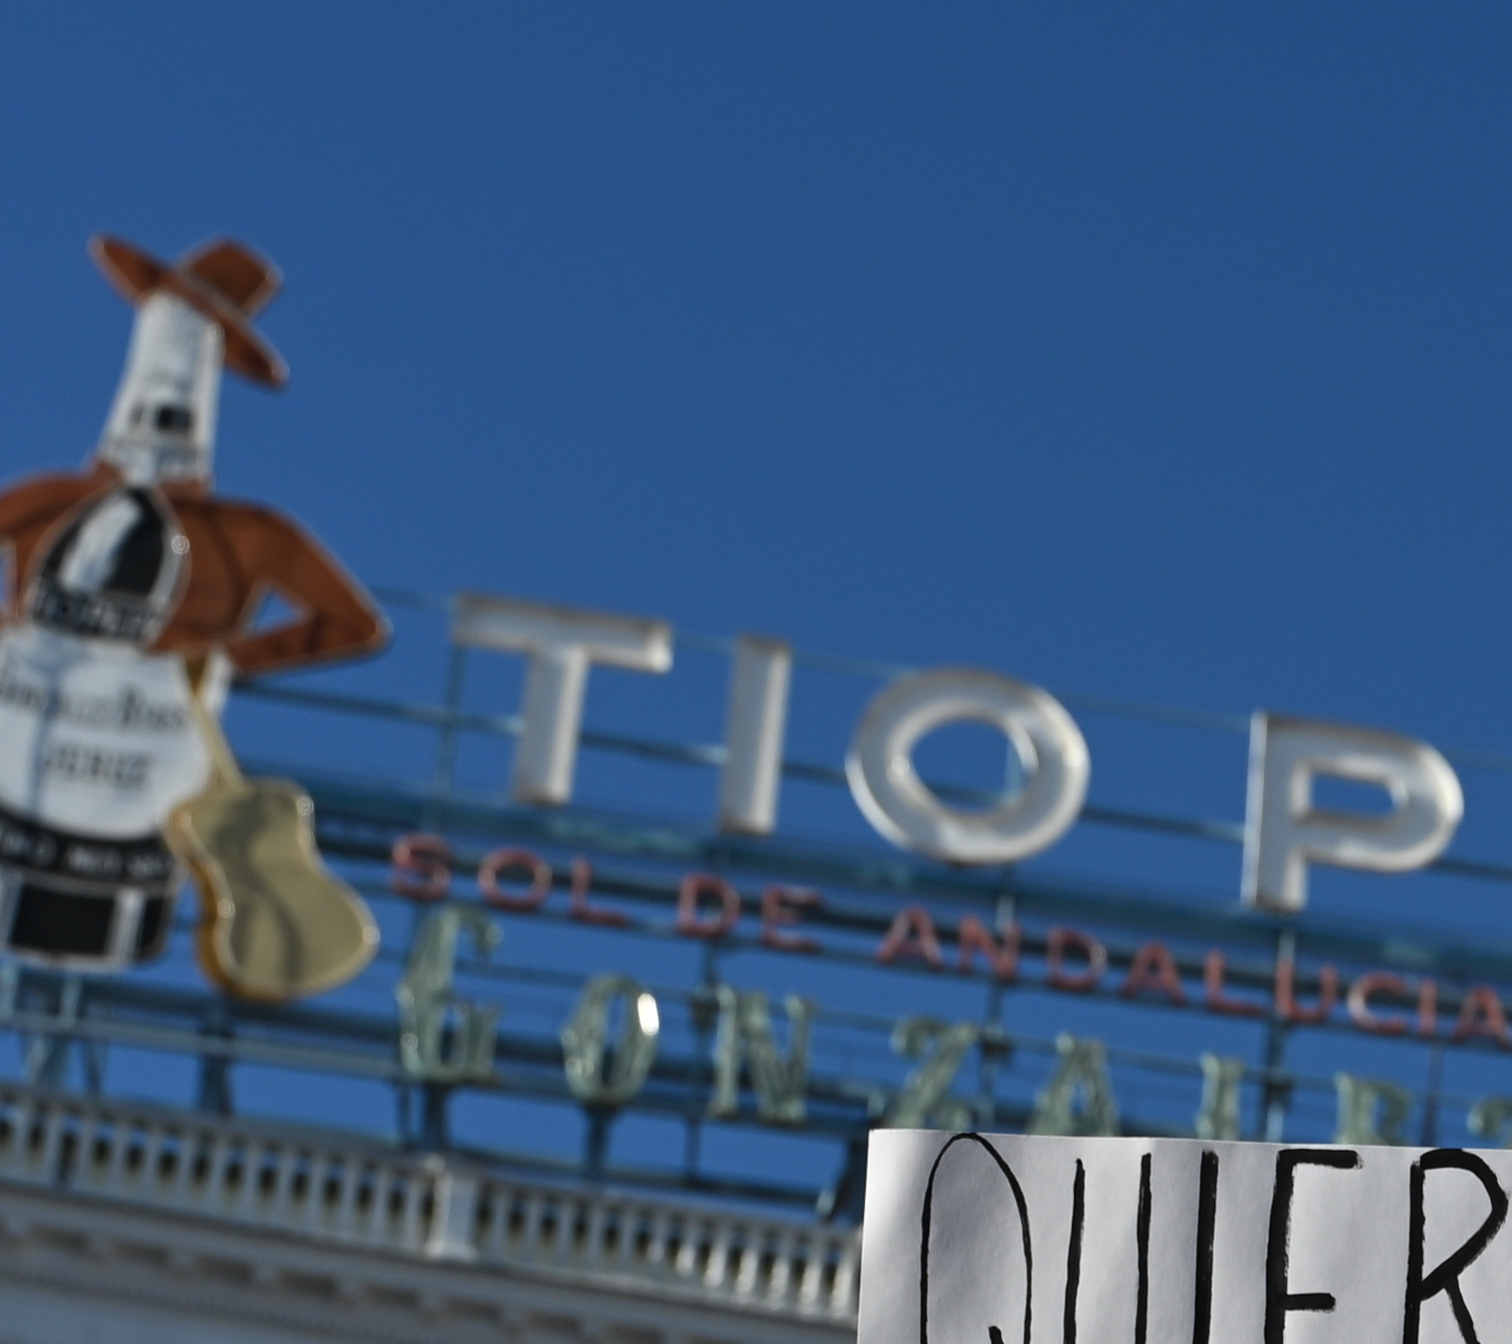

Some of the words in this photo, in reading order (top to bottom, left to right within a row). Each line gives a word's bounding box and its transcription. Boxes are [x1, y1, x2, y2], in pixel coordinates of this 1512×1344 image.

[448, 592, 1090, 866] TIO
[391, 834, 631, 928] SOL
[676, 871, 824, 954] DE
[875, 905, 1512, 1050] ANDALUCIA
